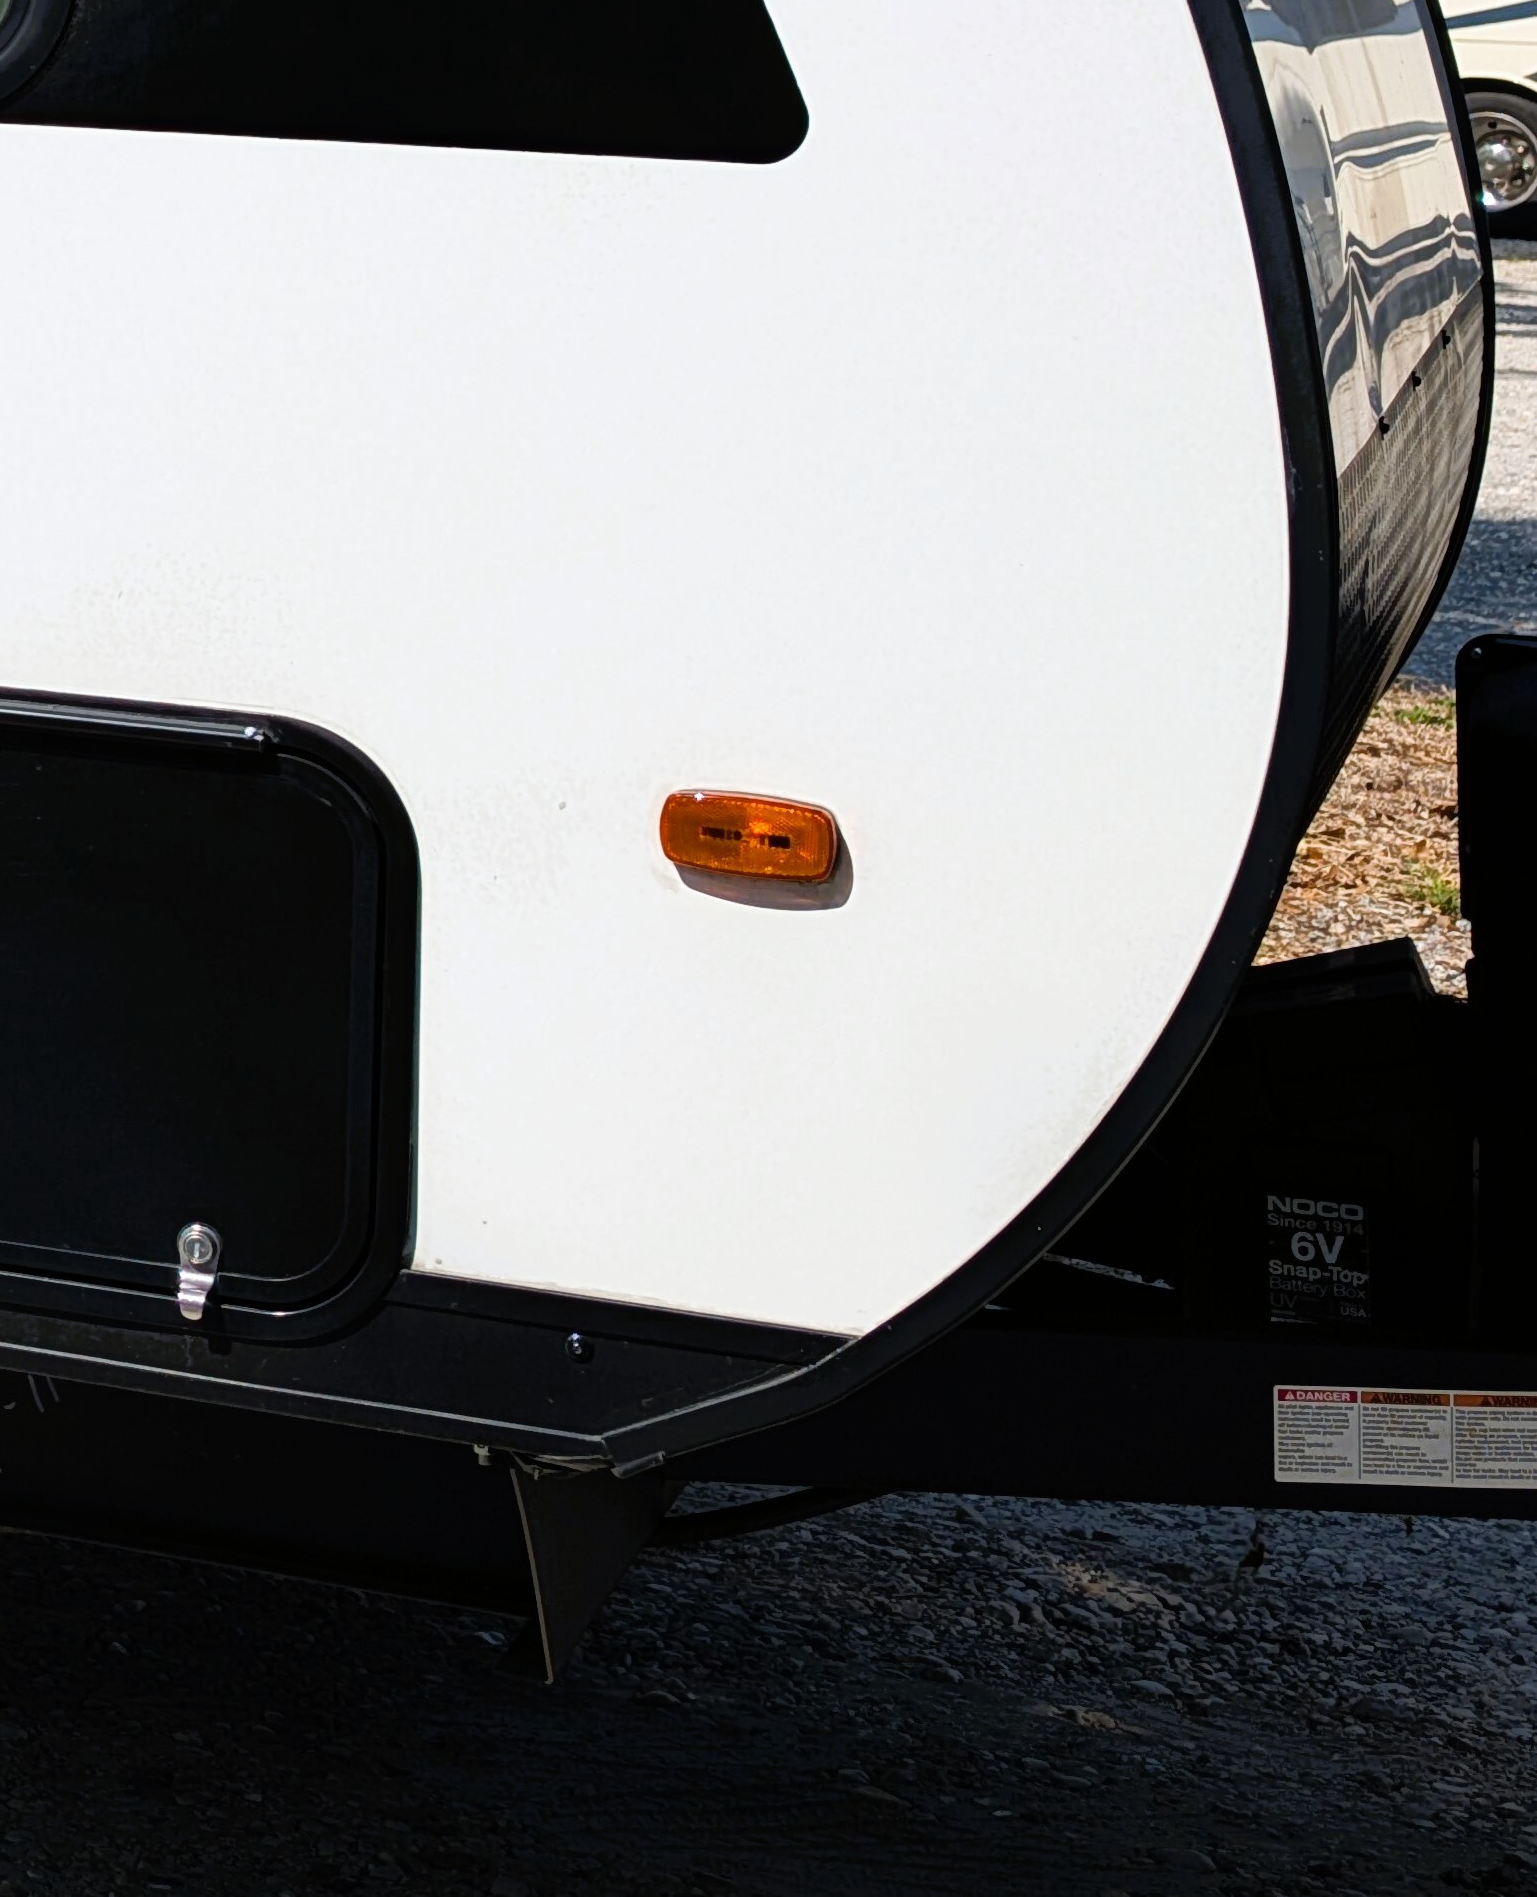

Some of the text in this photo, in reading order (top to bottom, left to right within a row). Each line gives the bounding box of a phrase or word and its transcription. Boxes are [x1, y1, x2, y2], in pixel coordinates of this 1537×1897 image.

[1266, 1194, 1365, 1221] NOCO
[1266, 1212, 1365, 1236] Since 1914
[1290, 1231, 1345, 1264] 6V
[1268, 1259, 1368, 1287] Snap-Top
[1269, 1275, 1366, 1300] Battery Box
[1269, 1291, 1298, 1309] UV
[1340, 1306, 1368, 1318] USA
[1295, 1390, 1351, 1403] DANGER
[1382, 1393, 1443, 1405] WARNING
